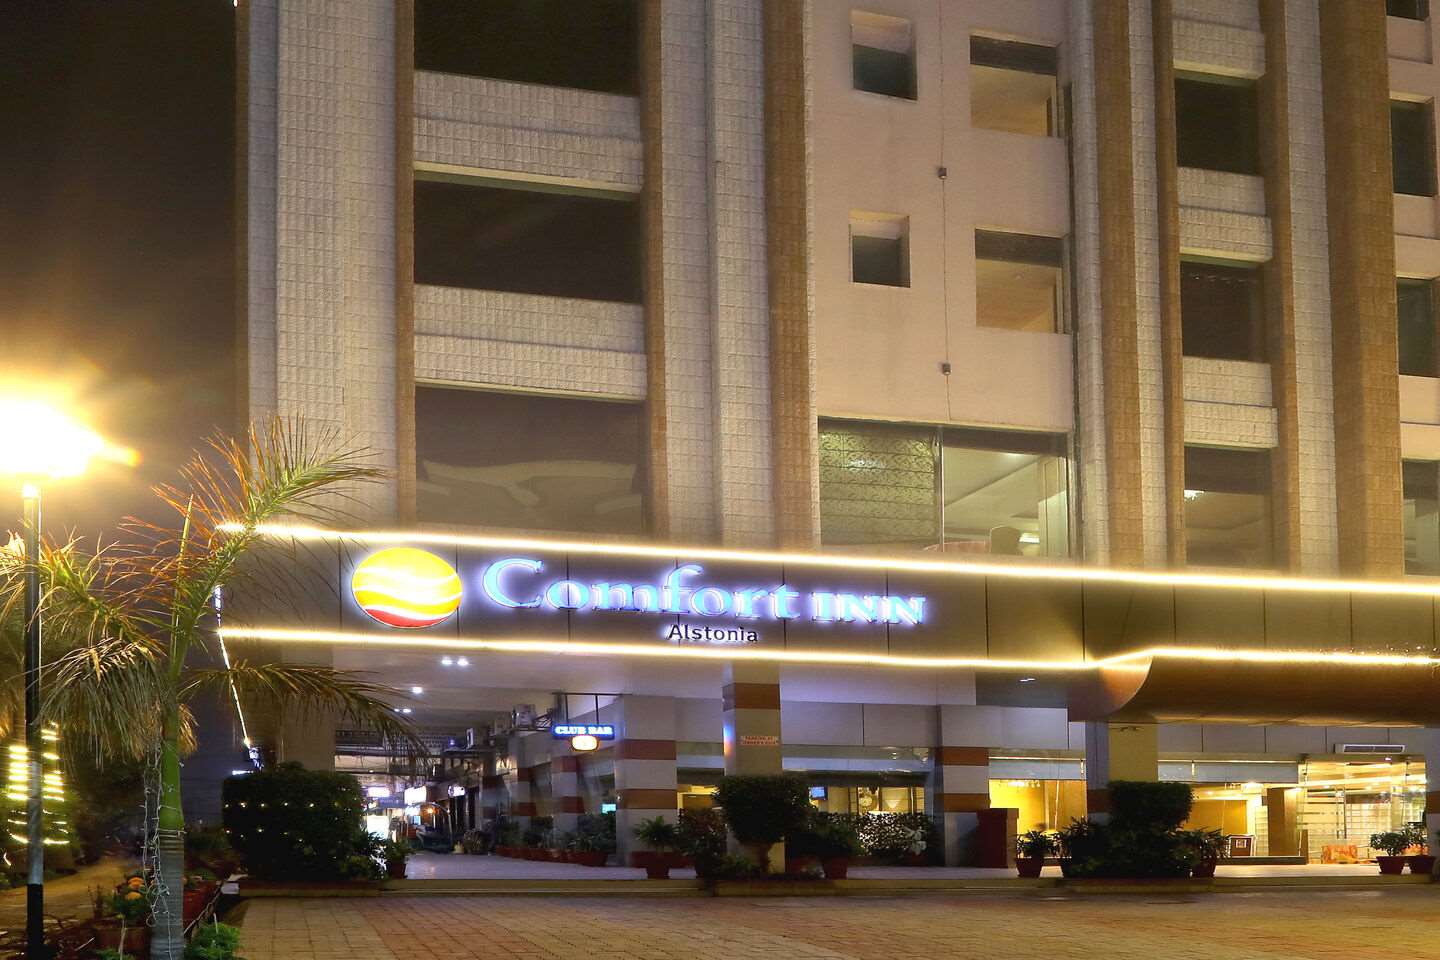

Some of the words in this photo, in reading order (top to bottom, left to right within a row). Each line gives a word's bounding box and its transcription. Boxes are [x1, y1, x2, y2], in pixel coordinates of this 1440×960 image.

[482, 558, 801, 620] Comfort
[811, 591, 926, 625] INN
[667, 624, 759, 643] Alstonia
